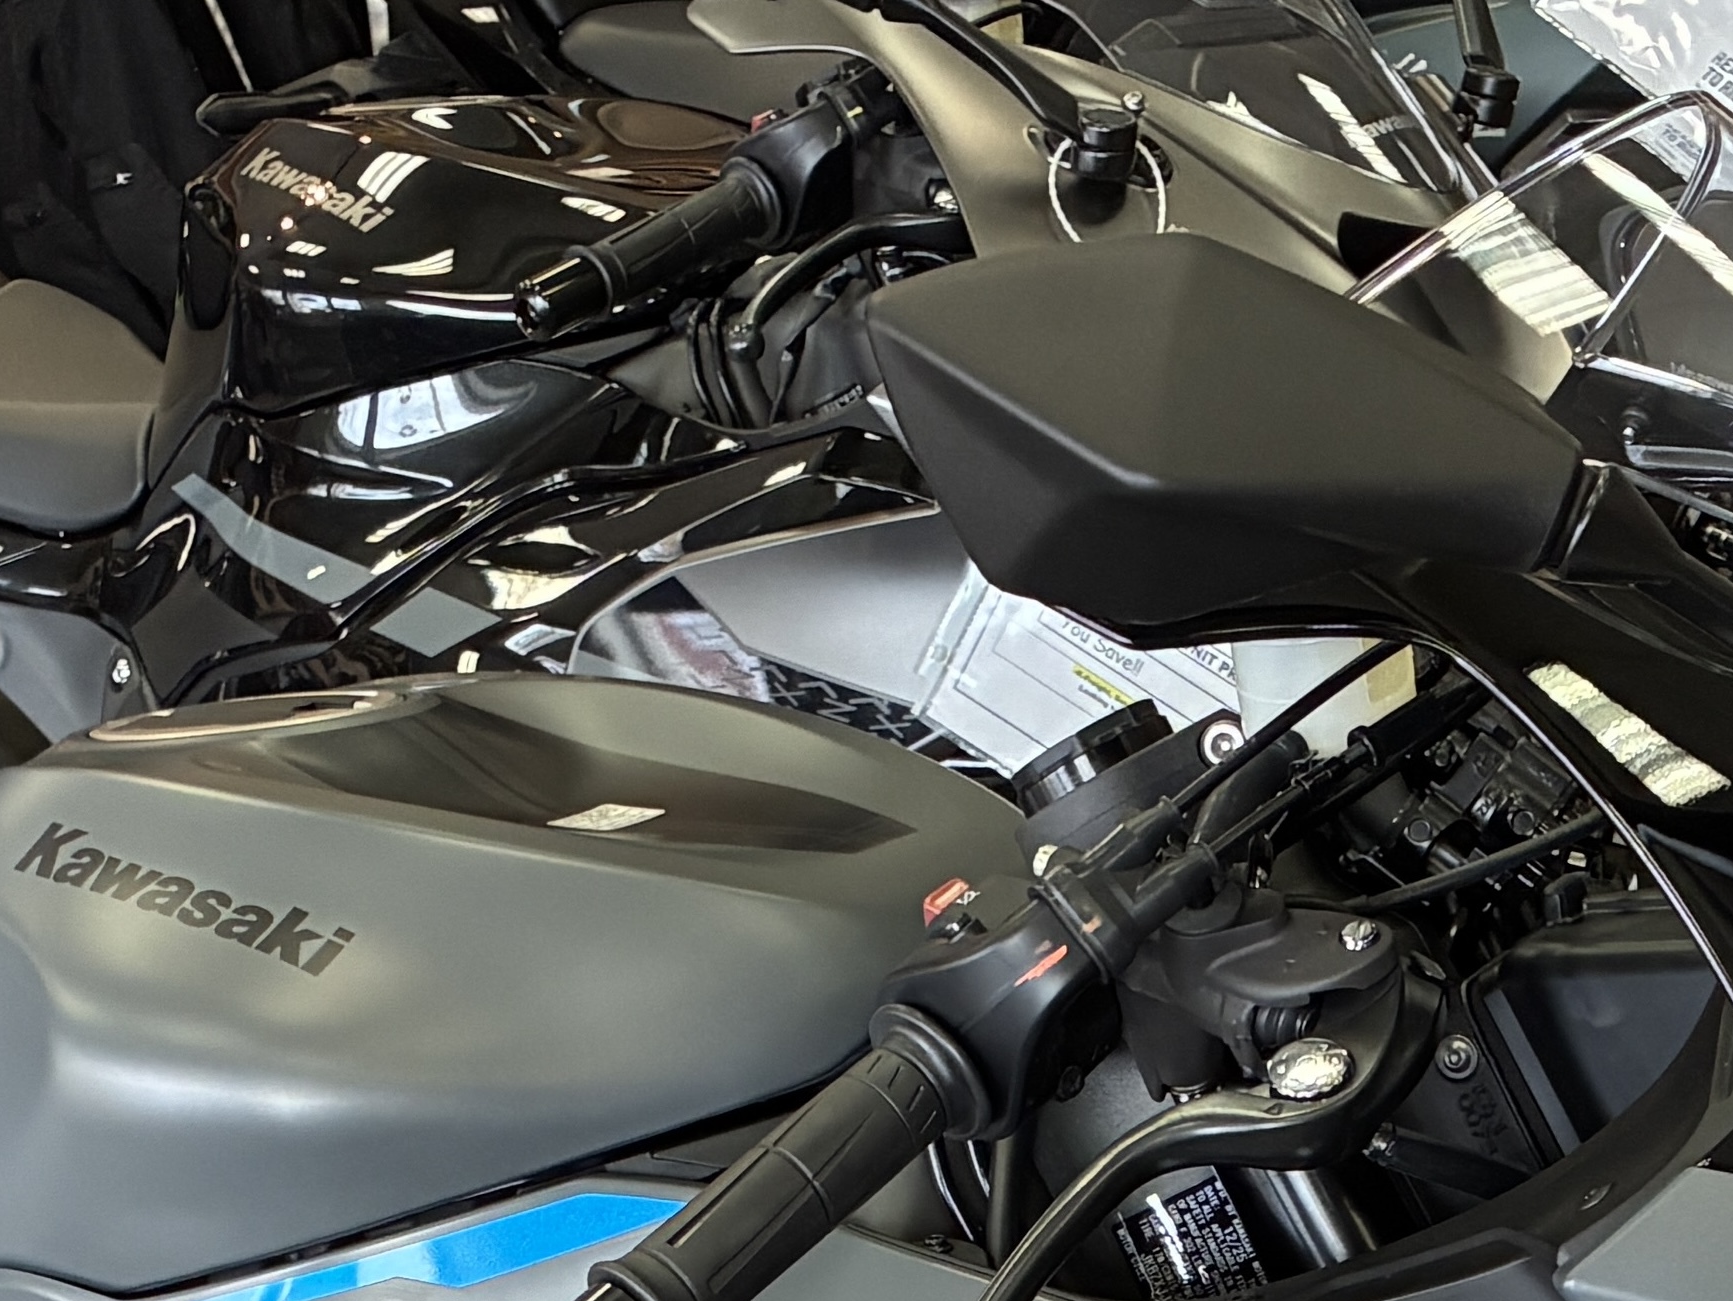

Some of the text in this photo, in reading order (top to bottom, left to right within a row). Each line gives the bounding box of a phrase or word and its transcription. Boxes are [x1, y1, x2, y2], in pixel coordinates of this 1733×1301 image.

[1187, 644, 1219, 668] NIT
[14, 822, 356, 976] Kawasaki
[1221, 1225, 1248, 1265] 12/25
